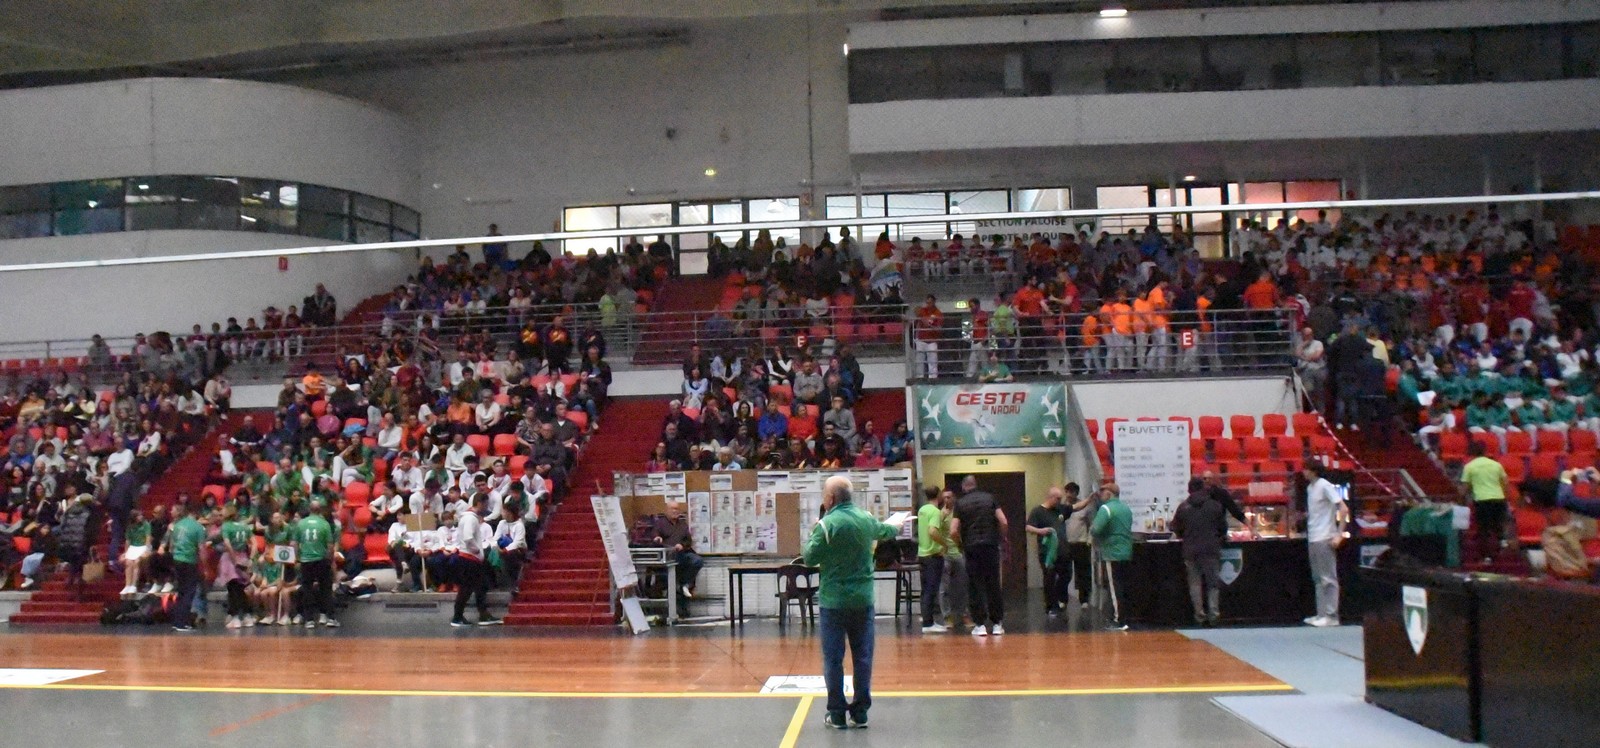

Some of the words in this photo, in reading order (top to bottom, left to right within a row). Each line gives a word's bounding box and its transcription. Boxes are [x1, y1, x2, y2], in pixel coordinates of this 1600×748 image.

[978, 218, 1022, 227] SECTION
[1025, 217, 1066, 226] PALOISE
[798, 335, 806, 348] E
[1183, 332, 1192, 346] E
[956, 391, 1027, 405] CESTA
[990, 405, 1021, 415] NADAU
[1129, 425, 1173, 434] BUVETTE
